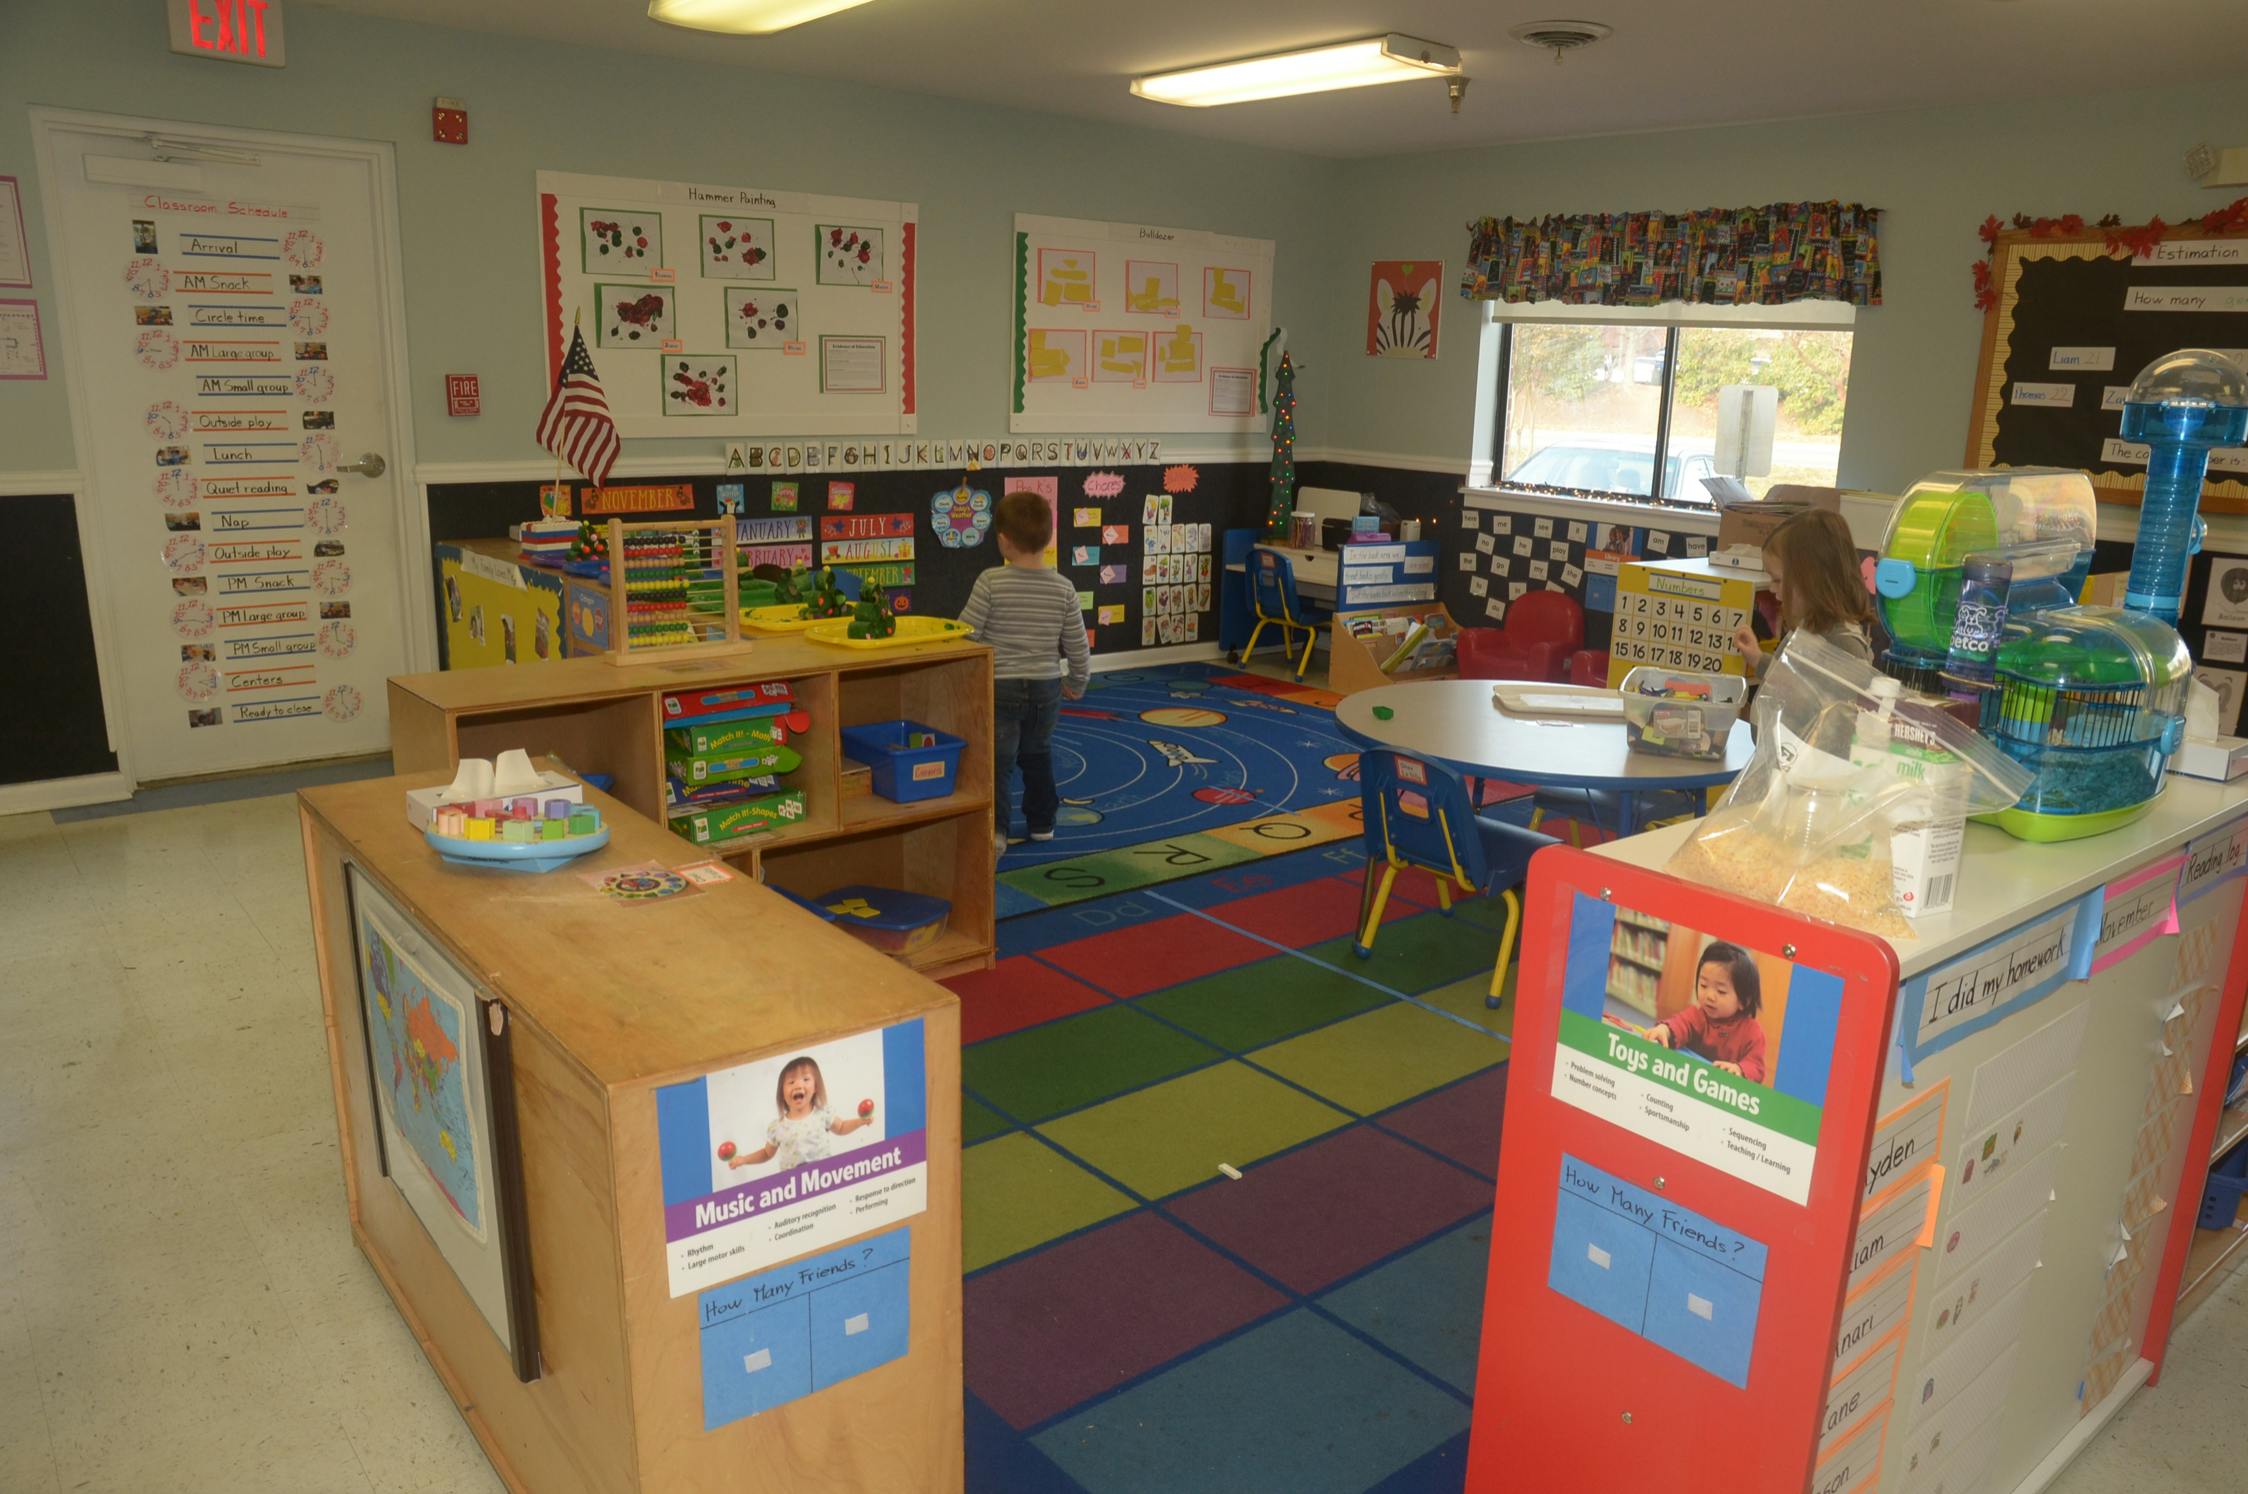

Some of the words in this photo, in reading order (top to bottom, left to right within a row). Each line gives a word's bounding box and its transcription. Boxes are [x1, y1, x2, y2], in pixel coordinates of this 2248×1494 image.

[188, 0, 268, 58] EXIT
[144, 195, 218, 214] Classroom
[228, 201, 288, 218] Schedule
[688, 187, 734, 203] Hammer
[740, 192, 776, 208] Painting
[191, 238, 238, 253] Arrival
[2157, 246, 2239, 260] Estimation
[184, 275, 206, 288] AM
[210, 276, 250, 290] Snack
[2134, 291, 2163, 304] How
[2170, 296, 2206, 309] many
[195, 308, 233, 322] Circle
[239, 311, 265, 323] time
[191, 344, 209, 357] AM
[212, 345, 242, 361] Large
[243, 350, 275, 361] group
[202, 379, 222, 392] AM
[224, 381, 254, 392] Small
[257, 383, 289, 395] group
[452, 380, 477, 396] FIRE
[200, 415, 243, 428] Outside
[248, 418, 272, 430] play
[213, 447, 253, 461] Lunch
[2111, 443, 2132, 459] The
[206, 481, 240, 494] Quiet
[244, 481, 288, 495] reading
[1087, 479, 1121, 492] Chores
[601, 487, 674, 511] NOVEMBER
[221, 515, 249, 528] Nap
[736, 520, 791, 541] JANUARY
[849, 518, 886, 537] JULY
[845, 541, 894, 560] AUGUST
[1652, 537, 1665, 545] am
[1687, 541, 1706, 551] have
[214, 546, 263, 560] Outside
[266, 546, 291, 559] play
[227, 577, 248, 590] PM
[254, 574, 295, 588] Snack
[1656, 577, 1705, 596] Numbers
[222, 610, 240, 623] PM
[243, 611, 272, 623] Large
[275, 610, 305, 621] group
[1622, 596, 1627, 609] 1
[1638, 599, 1647, 612] 2
[1656, 602, 1665, 616] 3
[1675, 604, 1684, 619] 4
[1693, 607, 1703, 621] 5
[1712, 610, 1721, 624] 6
[1733, 613, 1743, 627] 7
[1619, 618, 1627, 633] 8
[1636, 621, 1645, 635] 9
[1653, 624, 1667, 639] 10
[1672, 626, 1683, 641] 11
[1689, 630, 1703, 644] 12
[1708, 634, 1723, 649] 13
[233, 642, 250, 655] PM
[252, 641, 281, 654] Small
[285, 642, 316, 653] group
[1615, 642, 1628, 656] 15
[1632, 644, 1645, 659] 16
[1650, 647, 1665, 662] 17
[1669, 650, 1683, 665] 18
[1687, 653, 1701, 668] 19
[1702, 657, 1722, 672] 20
[231, 675, 284, 688] Centers
[240, 706, 271, 719] Ready
[274, 704, 284, 715] to
[286, 703, 312, 713] close
[710, 732, 734, 750] Match
[1897, 762, 1925, 780] milk
[720, 812, 741, 831] Match
[1239, 821, 1311, 840] Q
[1133, 844, 1212, 866] R
[2187, 849, 2223, 884] Reading
[2227, 834, 2241, 864] log
[1044, 866, 1105, 888] S
[1928, 982, 1947, 1024] I
[1947, 970, 1979, 1015] did
[1982, 975, 2004, 1007] my
[2006, 927, 2065, 987] homework
[1570, 1061, 1594, 1079] Problem
[1595, 1070, 1615, 1088] solving
[1608, 1032, 1648, 1072] Toys
[1652, 1056, 1690, 1088] and
[1694, 1067, 1760, 1116] Games
[1569, 1074, 1592, 1091] Number
[1592, 1083, 1617, 1101] concepts
[1646, 1093, 1674, 1112] Counting
[1644, 1106, 1690, 1132] Sportsmanship
[1728, 1127, 1767, 1151] Sequencing
[1727, 1141, 1755, 1160] Teaching
[1761, 1154, 1791, 1176] Learning
[1865, 1136, 1915, 1194] yden
[695, 1192, 755, 1229] Music
[760, 1176, 796, 1208] and
[801, 1147, 902, 1195] Movement
[854, 1188, 883, 1204] Response
[883, 1186, 890, 1195] to
[890, 1177, 916, 1192] direction
[855, 1197, 888, 1215] Performing
[1566, 1164, 1600, 1194] How
[1611, 1185, 1654, 1225] Many
[1662, 1209, 1727, 1254] Friends
[774, 1213, 802, 1229] Auditory
[802, 1203, 837, 1222] recognition
[774, 1223, 814, 1241] Coordination
[686, 1242, 714, 1259] Rhythm
[688, 1258, 706, 1270] Large
[707, 1251, 728, 1264] motor
[729, 1245, 745, 1258] skills
[1849, 1234, 1884, 1274] iam
[705, 1298, 742, 1322] How
[753, 1280, 793, 1302] Many
[798, 1257, 856, 1286] Friends
